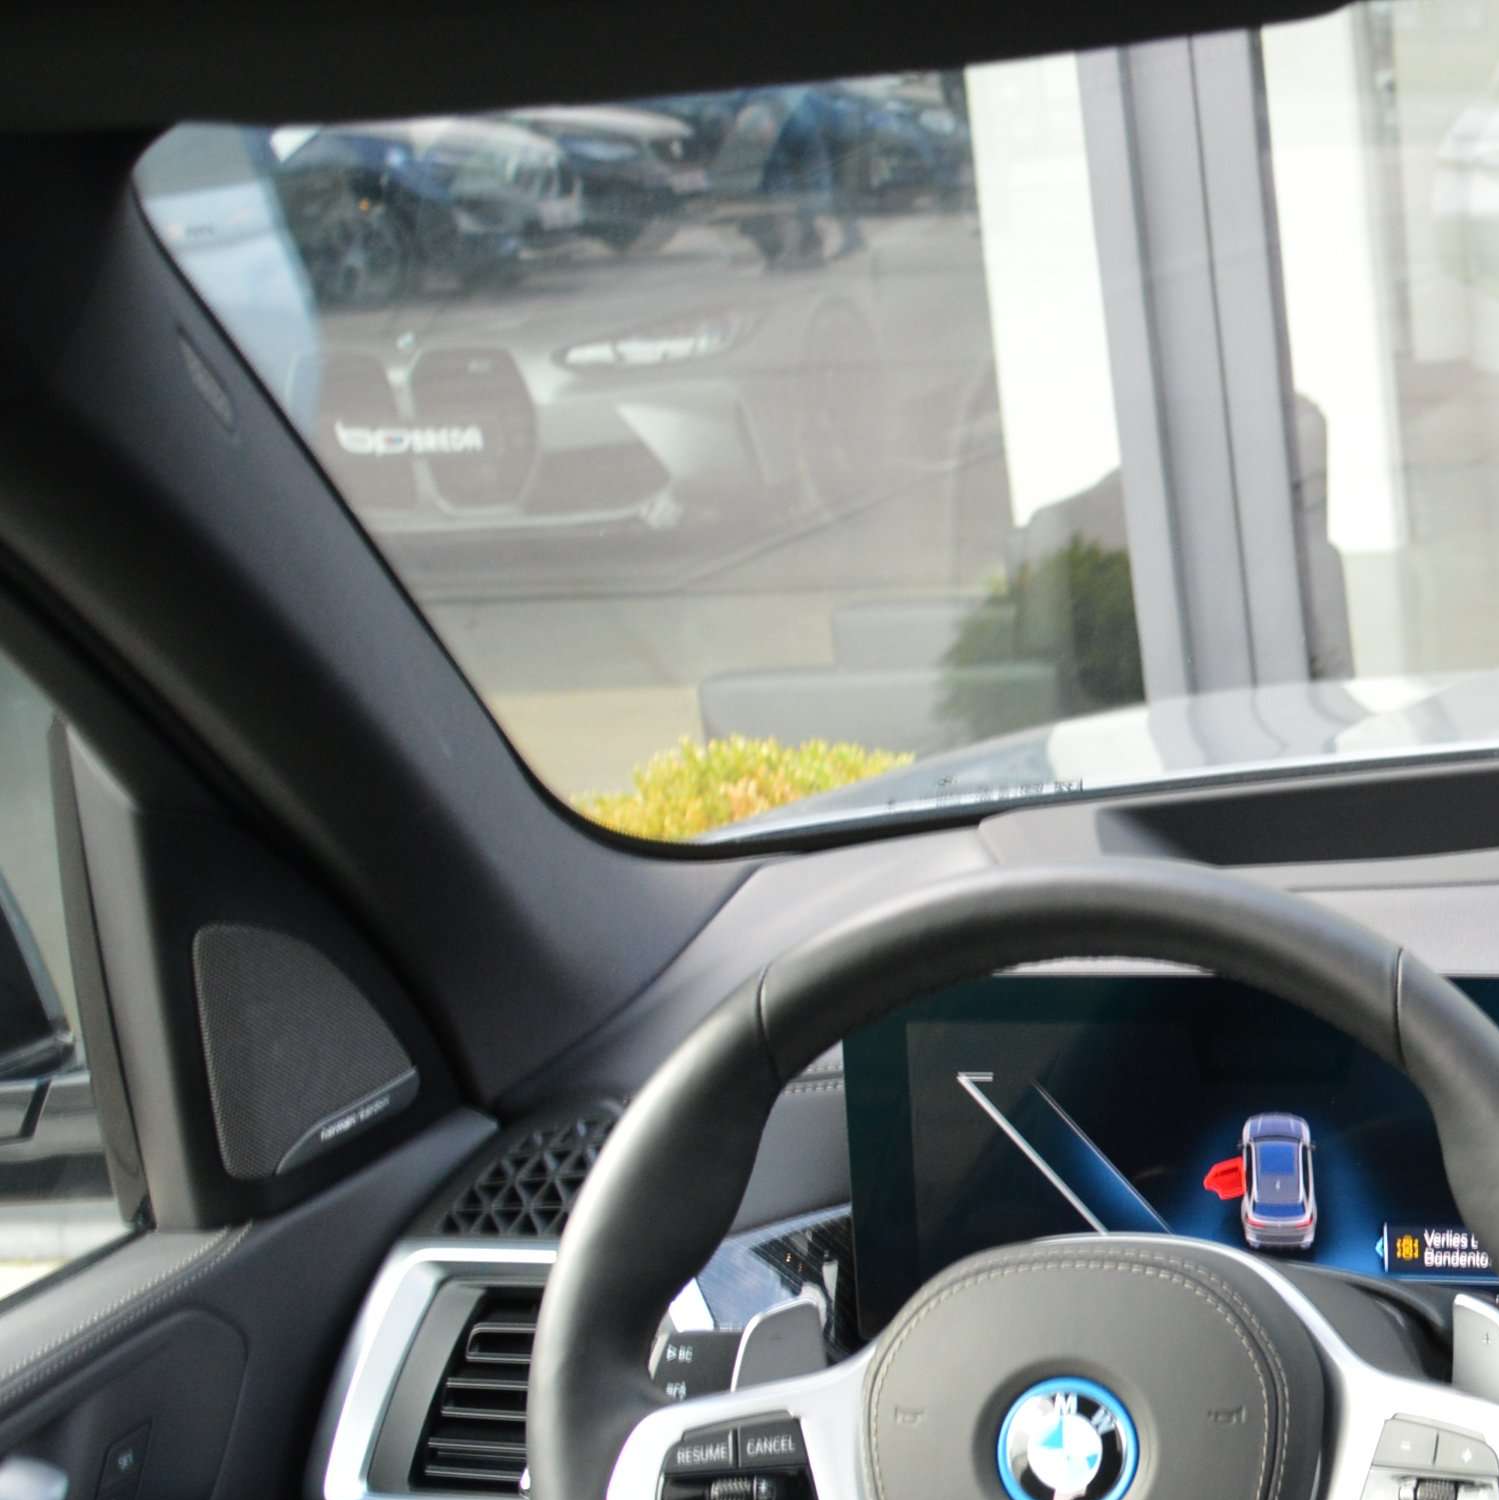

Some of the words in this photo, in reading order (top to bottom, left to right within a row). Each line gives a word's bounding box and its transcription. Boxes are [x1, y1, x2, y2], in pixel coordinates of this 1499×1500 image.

[1424, 1229, 1468, 1248] Verlies
[676, 1442, 728, 1465] RESUME
[746, 1434, 796, 1457] CANCEL
